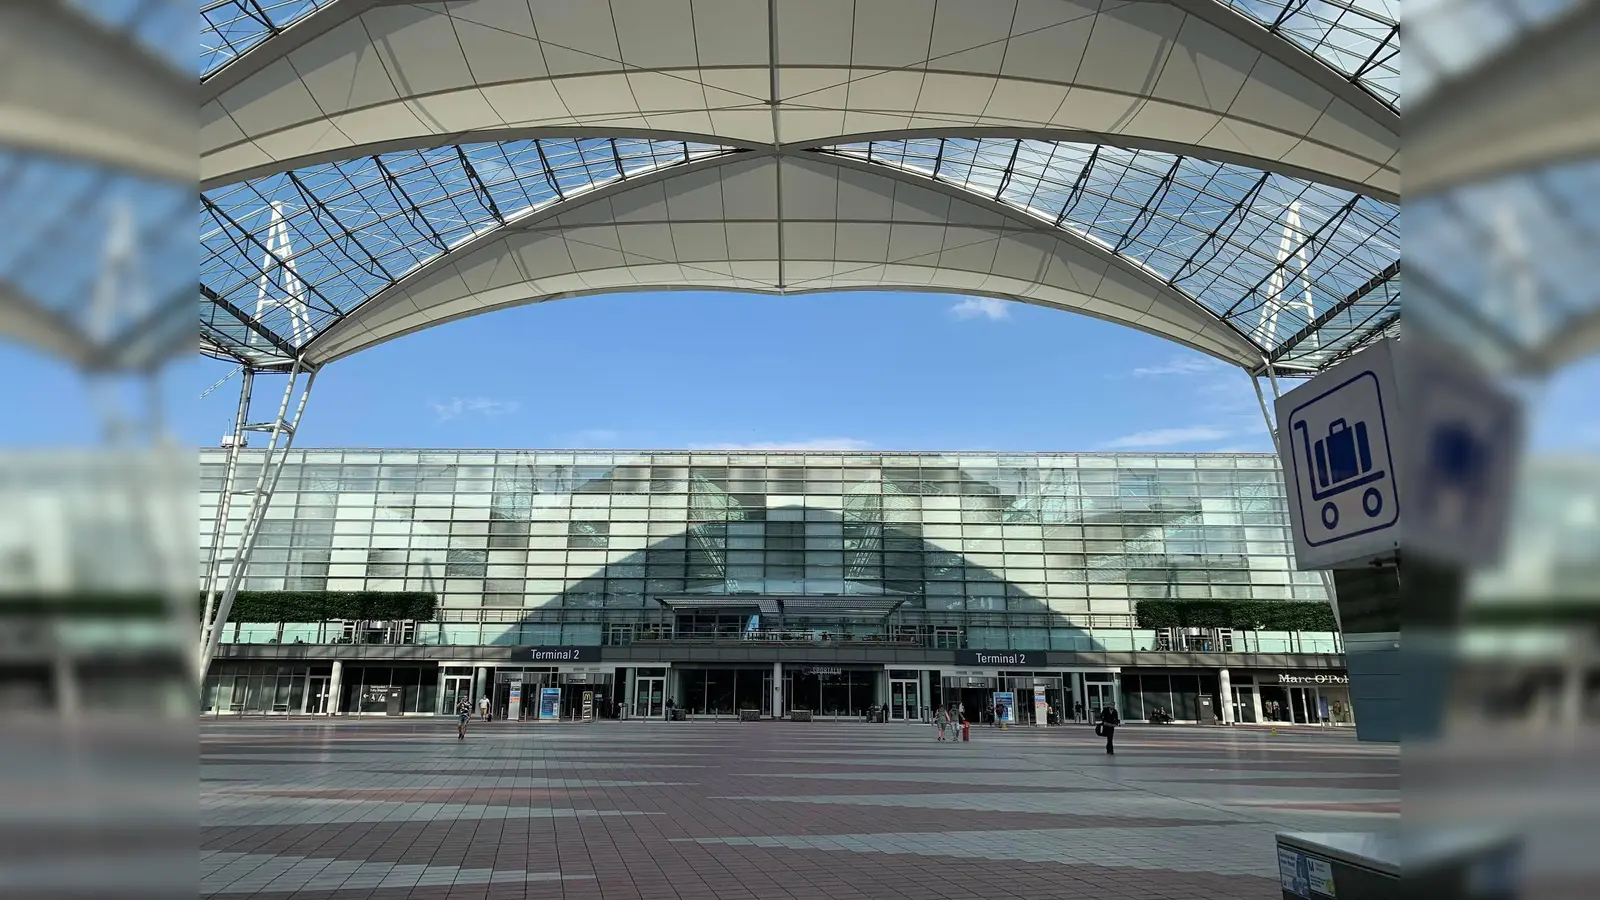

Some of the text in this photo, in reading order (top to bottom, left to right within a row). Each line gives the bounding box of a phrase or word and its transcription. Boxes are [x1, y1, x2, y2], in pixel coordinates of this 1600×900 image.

[531, 649, 579, 660] Terminal 2
[975, 652, 1026, 664] Terminal 2
[1278, 674, 1349, 684] Marc O'Pol
